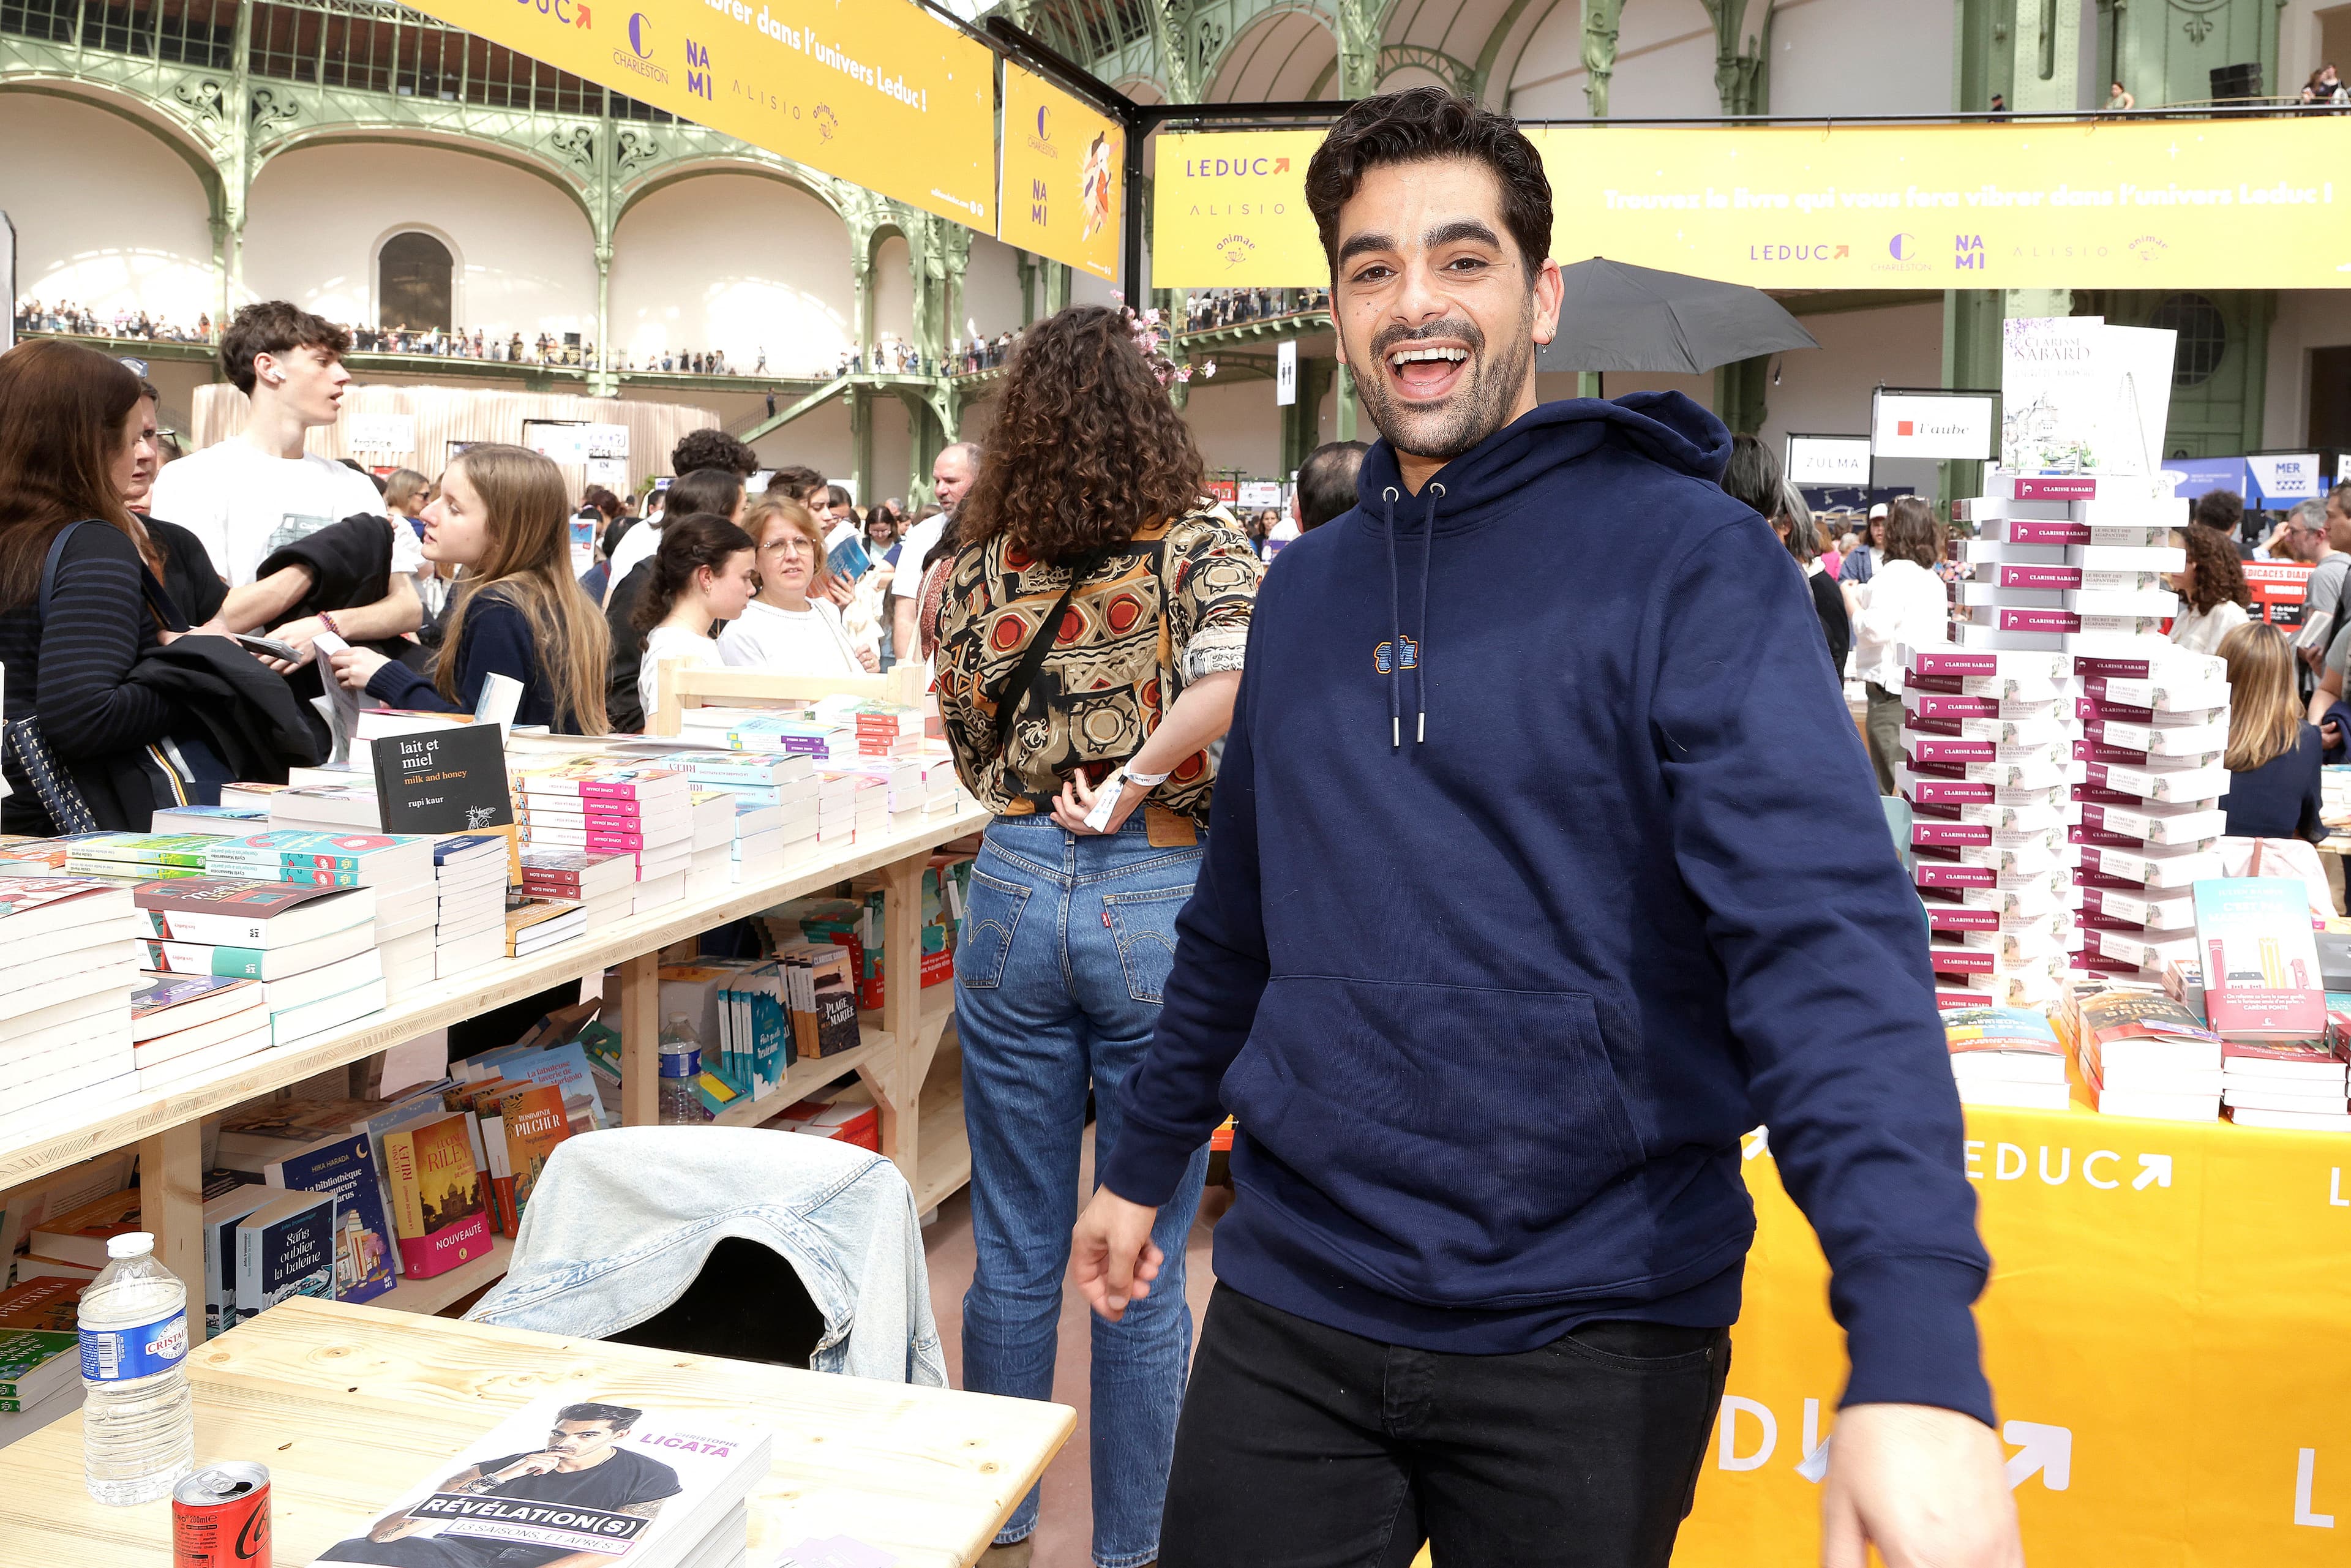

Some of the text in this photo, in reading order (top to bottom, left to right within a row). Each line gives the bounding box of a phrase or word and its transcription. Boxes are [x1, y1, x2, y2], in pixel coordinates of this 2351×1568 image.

[686, 38, 711, 70] NA
[757, 2, 801, 51] dans
[804, 26, 874, 88] l'univers
[877, 66, 919, 110] Leduc
[920, 88, 928, 113] !
[613, 51, 669, 85] CHARLESTON
[688, 69, 712, 101] MI
[1027, 135, 1059, 160] CHARLESTON
[1187, 157, 1269, 177] LEDUC
[1033, 178, 1048, 203] NA
[1603, 189, 1700, 209] Trouvez
[1705, 187, 1728, 209] le
[1734, 187, 1789, 209] livre
[1794, 187, 1836, 213] qui
[1840, 192, 1899, 209] vous
[1905, 186, 1959, 208] fera
[1964, 185, 2044, 206] vibrer
[2049, 183, 2113, 206] dans
[2238, 181, 2317, 205] Leduc
[1032, 203, 1047, 227] MI
[1217, 233, 1256, 251] animae
[1955, 234, 1984, 251] NA
[1751, 245, 1829, 260] LEDUC
[1955, 252, 1984, 269] MI
[1870, 263, 1932, 272] CHARLESTON
[2017, 347, 2090, 361] SABARD
[1807, 457, 1859, 469] ZULMA
[2276, 462, 2300, 475] MER
[400, 738, 440, 754] lait et
[402, 753, 433, 769] miel
[668, 763, 696, 773] RILEY
[404, 769, 468, 786] milk and honey
[408, 796, 444, 809] rupi kaur
[825, 997, 848, 1020] PLAGE
[536, 1060, 571, 1077] fabuleuse
[538, 1067, 572, 1083] laverie de
[515, 1114, 561, 1138] PILCHER
[312, 1154, 350, 1173] HIKA HARADA
[398, 1144, 413, 1180] RILEY
[427, 1142, 468, 1173] RILEY
[1965, 1140, 2120, 1190] EDUC
[315, 1168, 362, 1191] bibliothèque
[337, 1190, 354, 1204] arus
[286, 1226, 310, 1248] Sans
[435, 1220, 483, 1251] NOUVEAUTÉ
[280, 1240, 316, 1264] oublier
[274, 1250, 321, 1281] la baleine
[6, 1344, 45, 1362] vivre
[639, 1433, 731, 1458] LICATA
[674, 1431, 740, 1448] CHRISTOPHE
[190, 1515, 208, 1524] 200ml
[421, 1496, 638, 1538] RÉVÉLATION(S)
[546, 1533, 563, 1542] ET
[566, 1535, 612, 1551] APRÈS
